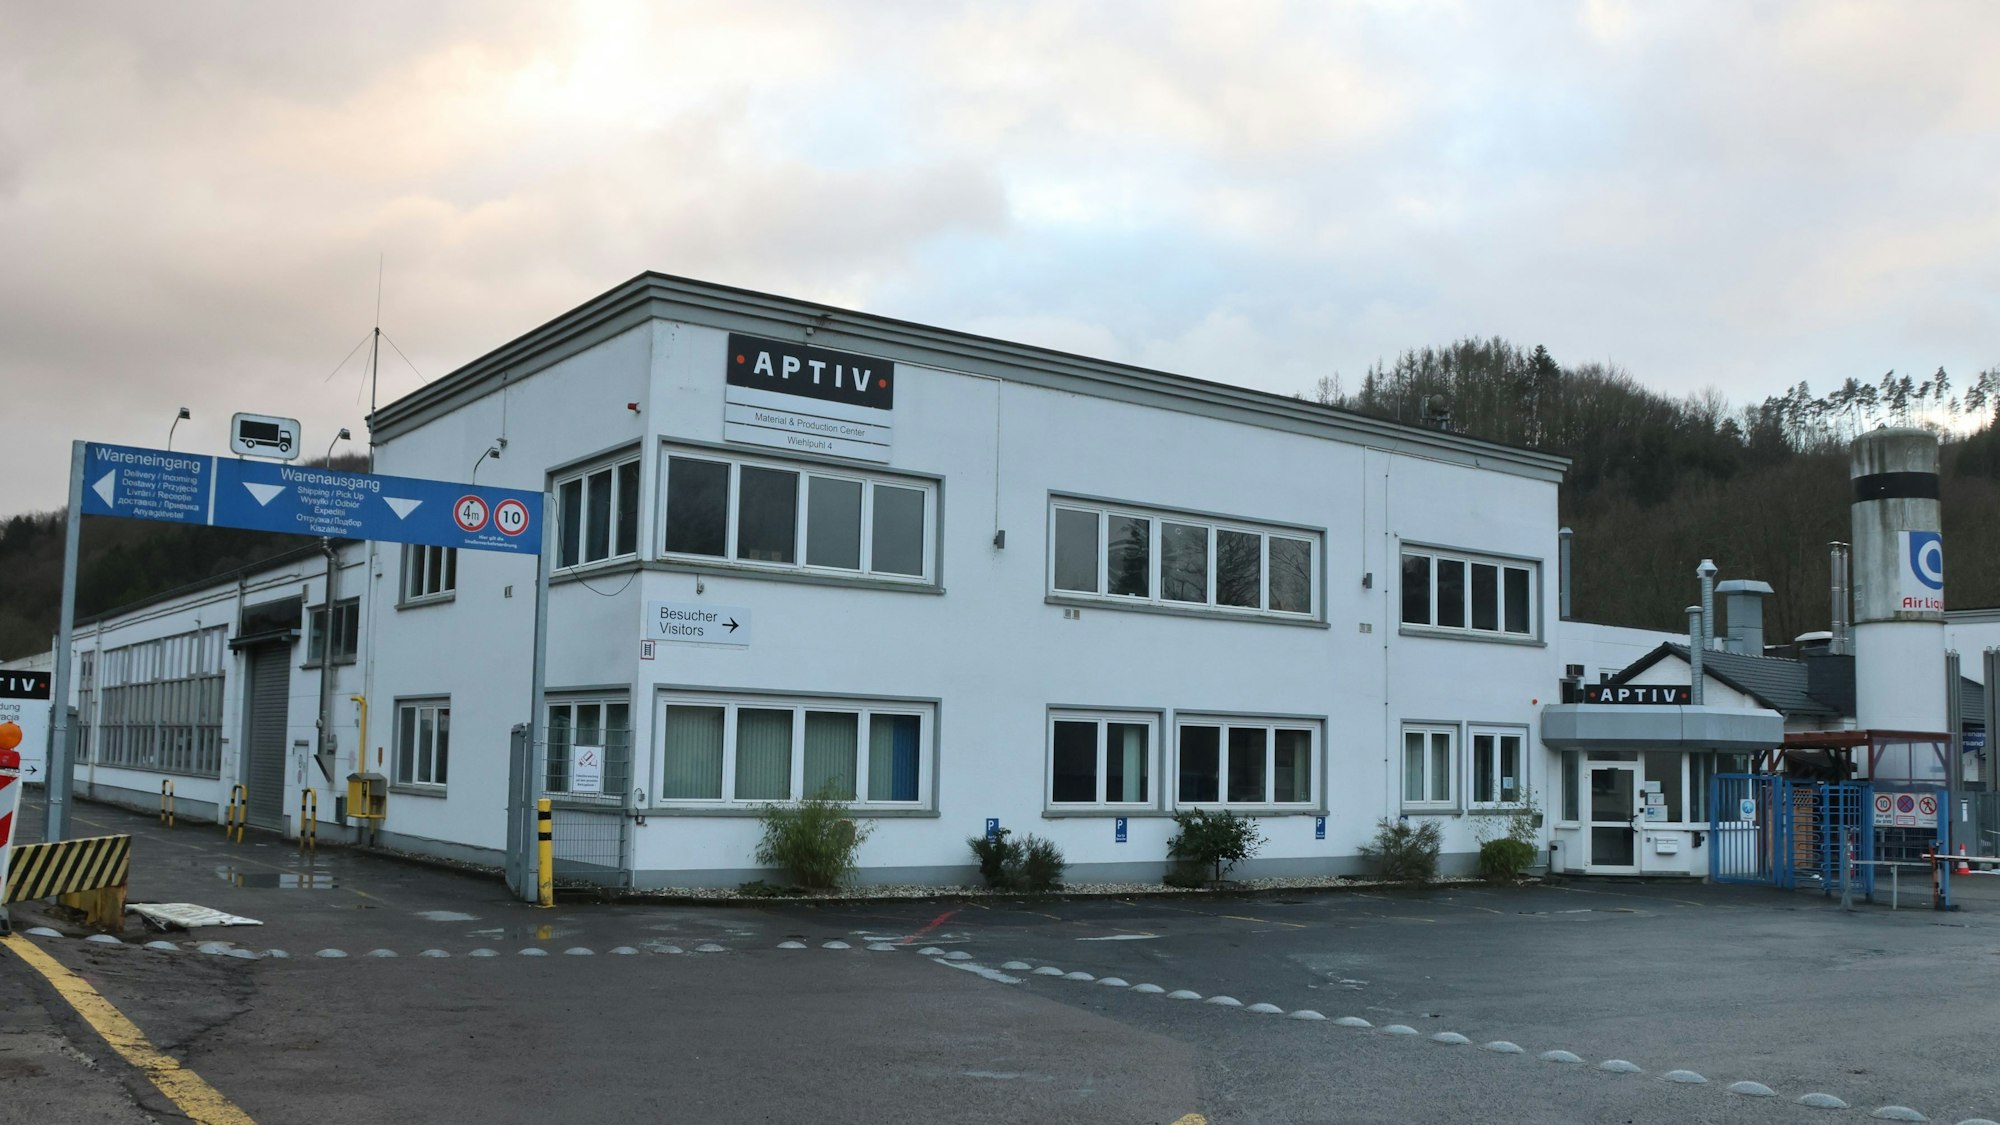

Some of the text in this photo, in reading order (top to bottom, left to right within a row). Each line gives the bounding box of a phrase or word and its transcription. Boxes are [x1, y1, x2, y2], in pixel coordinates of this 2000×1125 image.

[753, 351, 871, 392] APTIV
[755, 412, 865, 436] Material & Production Center
[787, 436, 825, 449] Wiehlpuhl
[95, 447, 201, 474] Wareneingang
[122, 478, 156, 490] Dostawy
[124, 469, 156, 481] Delivery
[162, 473, 198, 485] Incoming
[280, 467, 380, 493] Warenausgang
[297, 486, 330, 498] Shipping
[336, 490, 352, 498] Pick
[353, 492, 365, 501] Up
[504, 511, 520, 524] 10
[1903, 597, 1923, 608] Air
[660, 606, 718, 622] Besucher
[660, 622, 704, 636] Visitors
[1600, 688, 1676, 703] APTIV
[1880, 800, 1888, 808] 10
[988, 820, 994, 831] P
[1117, 819, 1123, 829] P
[1317, 818, 1322, 828] P
